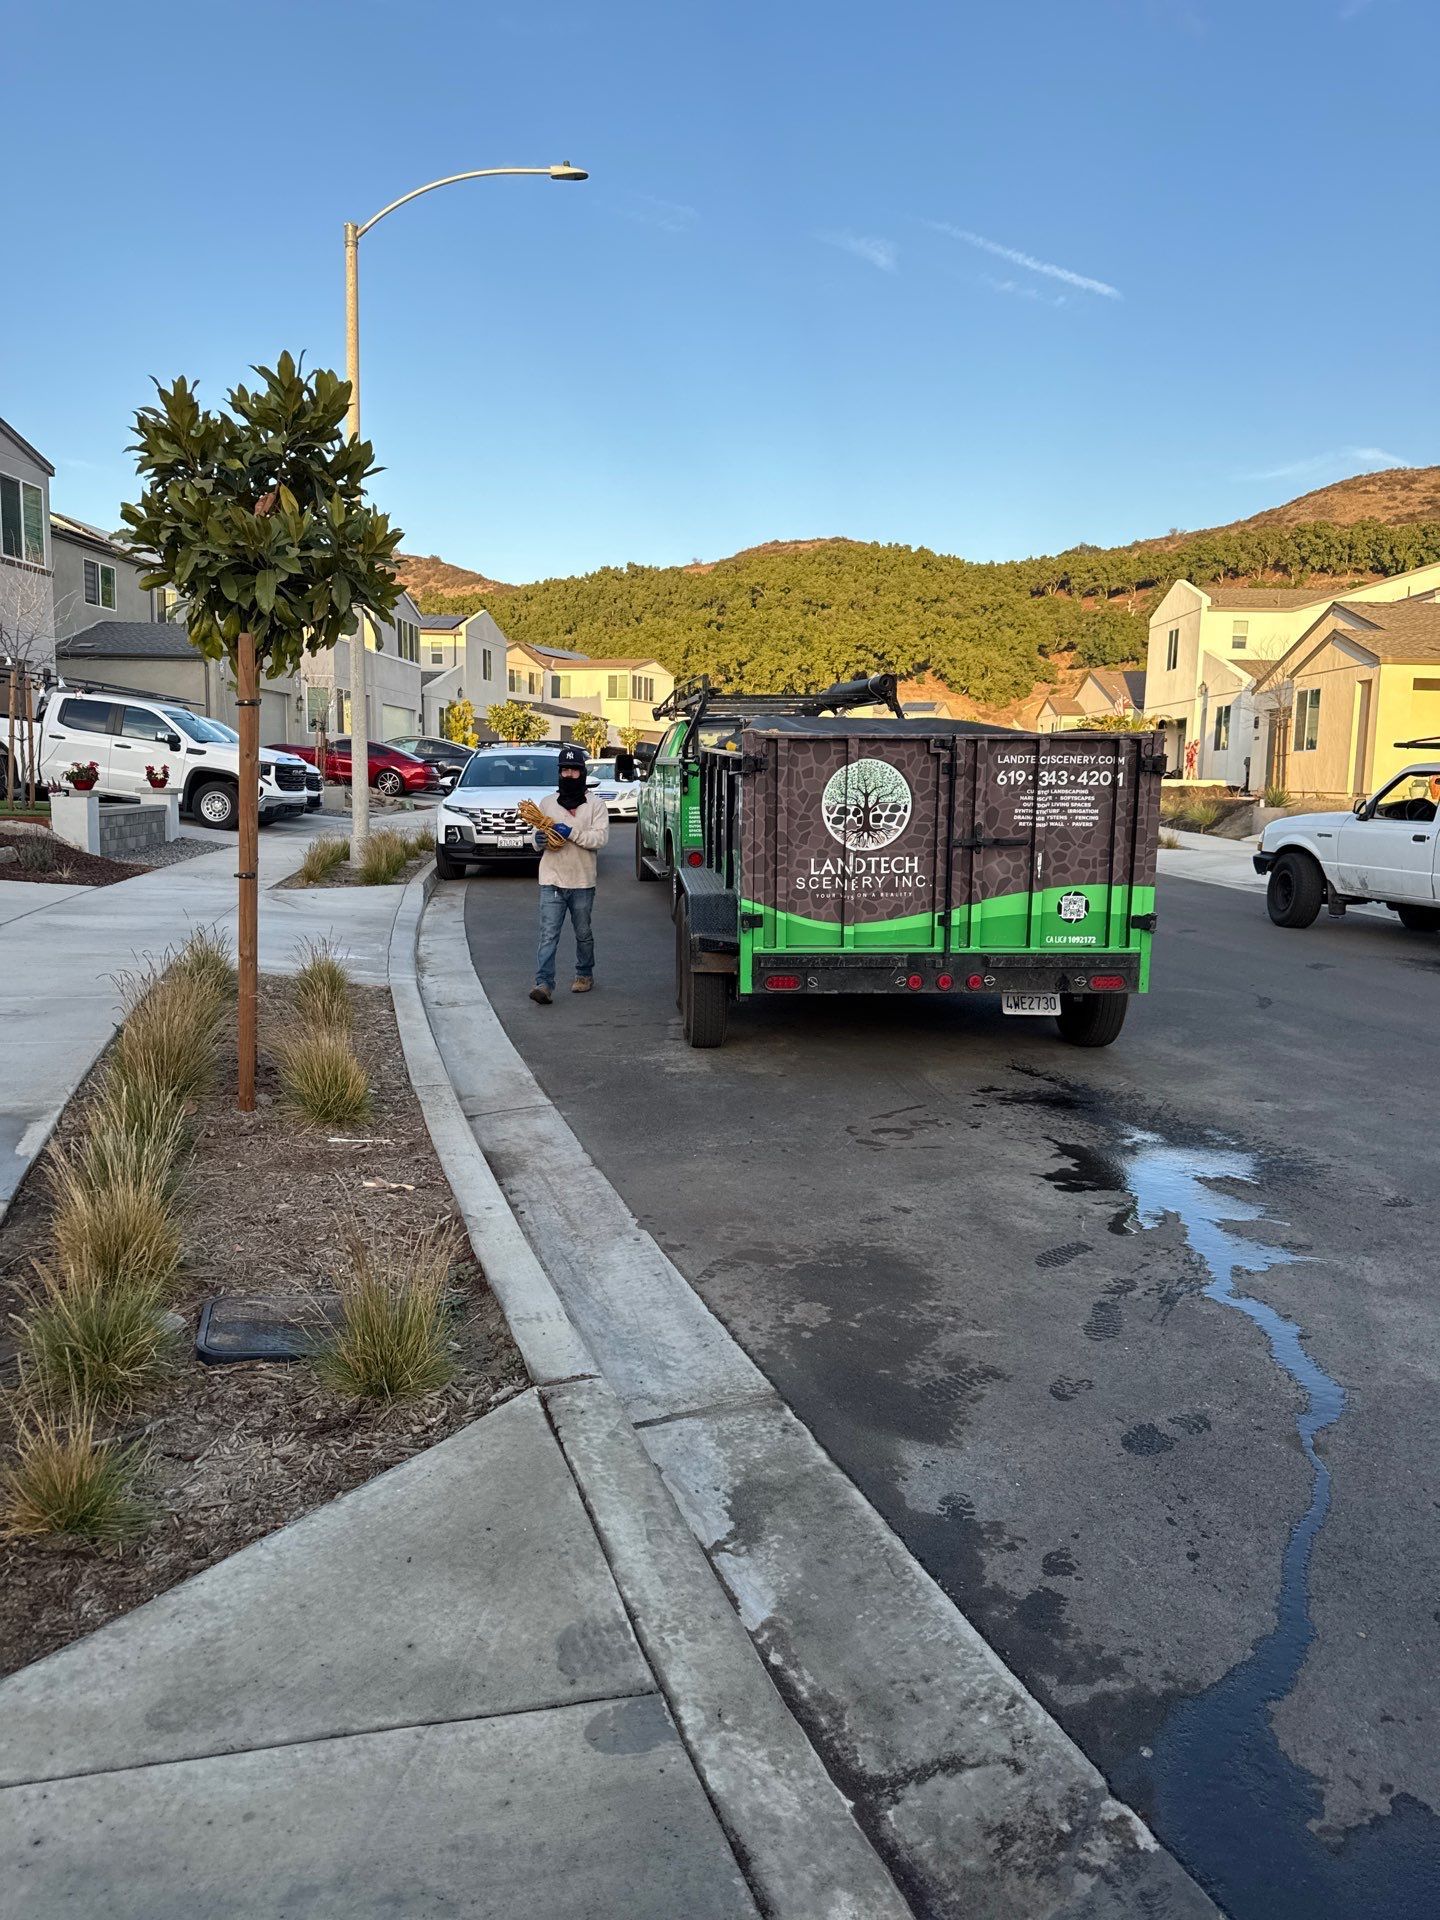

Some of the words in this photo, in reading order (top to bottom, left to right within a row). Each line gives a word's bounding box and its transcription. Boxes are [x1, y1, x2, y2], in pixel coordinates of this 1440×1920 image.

[810, 856, 919, 875] LANDTECH
[796, 876, 885, 890] SCENERY
[895, 875, 933, 887] INC.
[1006, 996, 1057, 1011] 4WE2730
